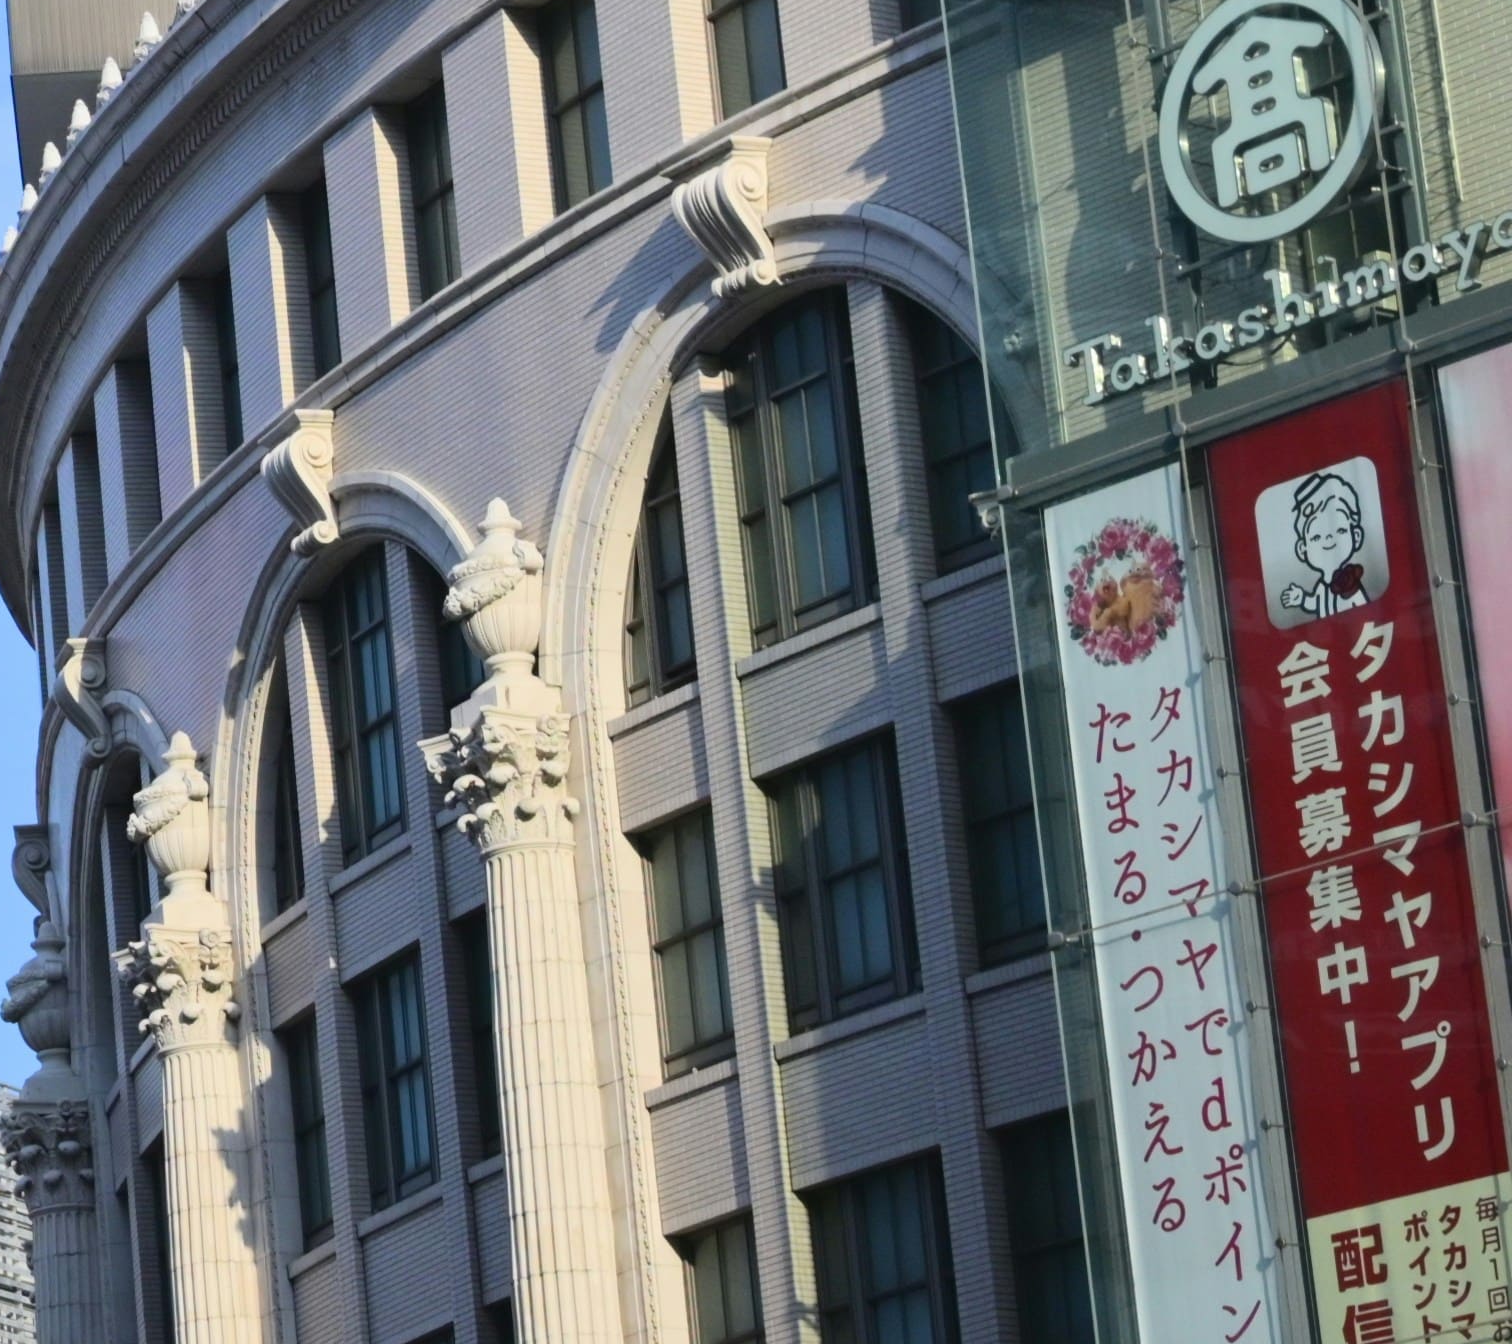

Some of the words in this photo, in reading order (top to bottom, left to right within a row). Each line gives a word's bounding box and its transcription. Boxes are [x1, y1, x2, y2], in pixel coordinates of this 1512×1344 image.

[1278, 640, 1365, 1075] 会員募集中!
[1351, 620, 1457, 1162] タカシマヤアプリ
